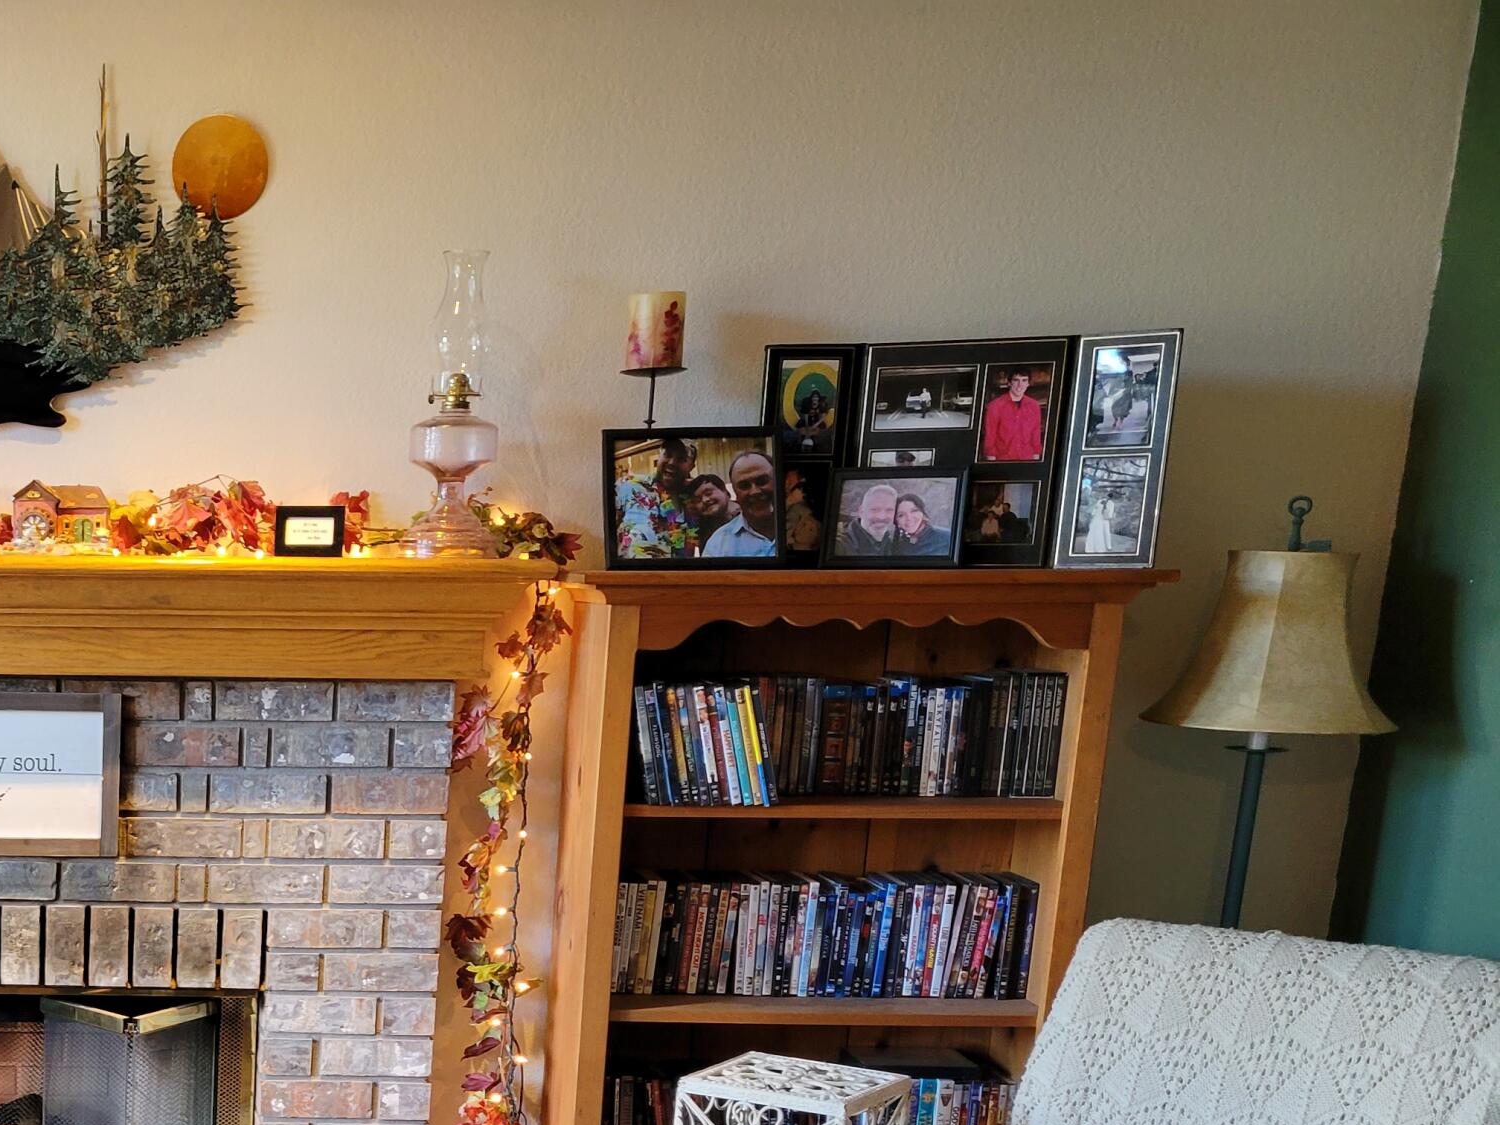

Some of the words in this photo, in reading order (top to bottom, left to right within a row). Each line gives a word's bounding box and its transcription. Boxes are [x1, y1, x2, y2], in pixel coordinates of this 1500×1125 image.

[931, 703, 943, 751] SKYFALL
[12, 753, 63, 773] soul.
[632, 887, 645, 930] VIETNAM
[705, 906, 716, 939] WONDER
[701, 941, 710, 970] WOMAN
